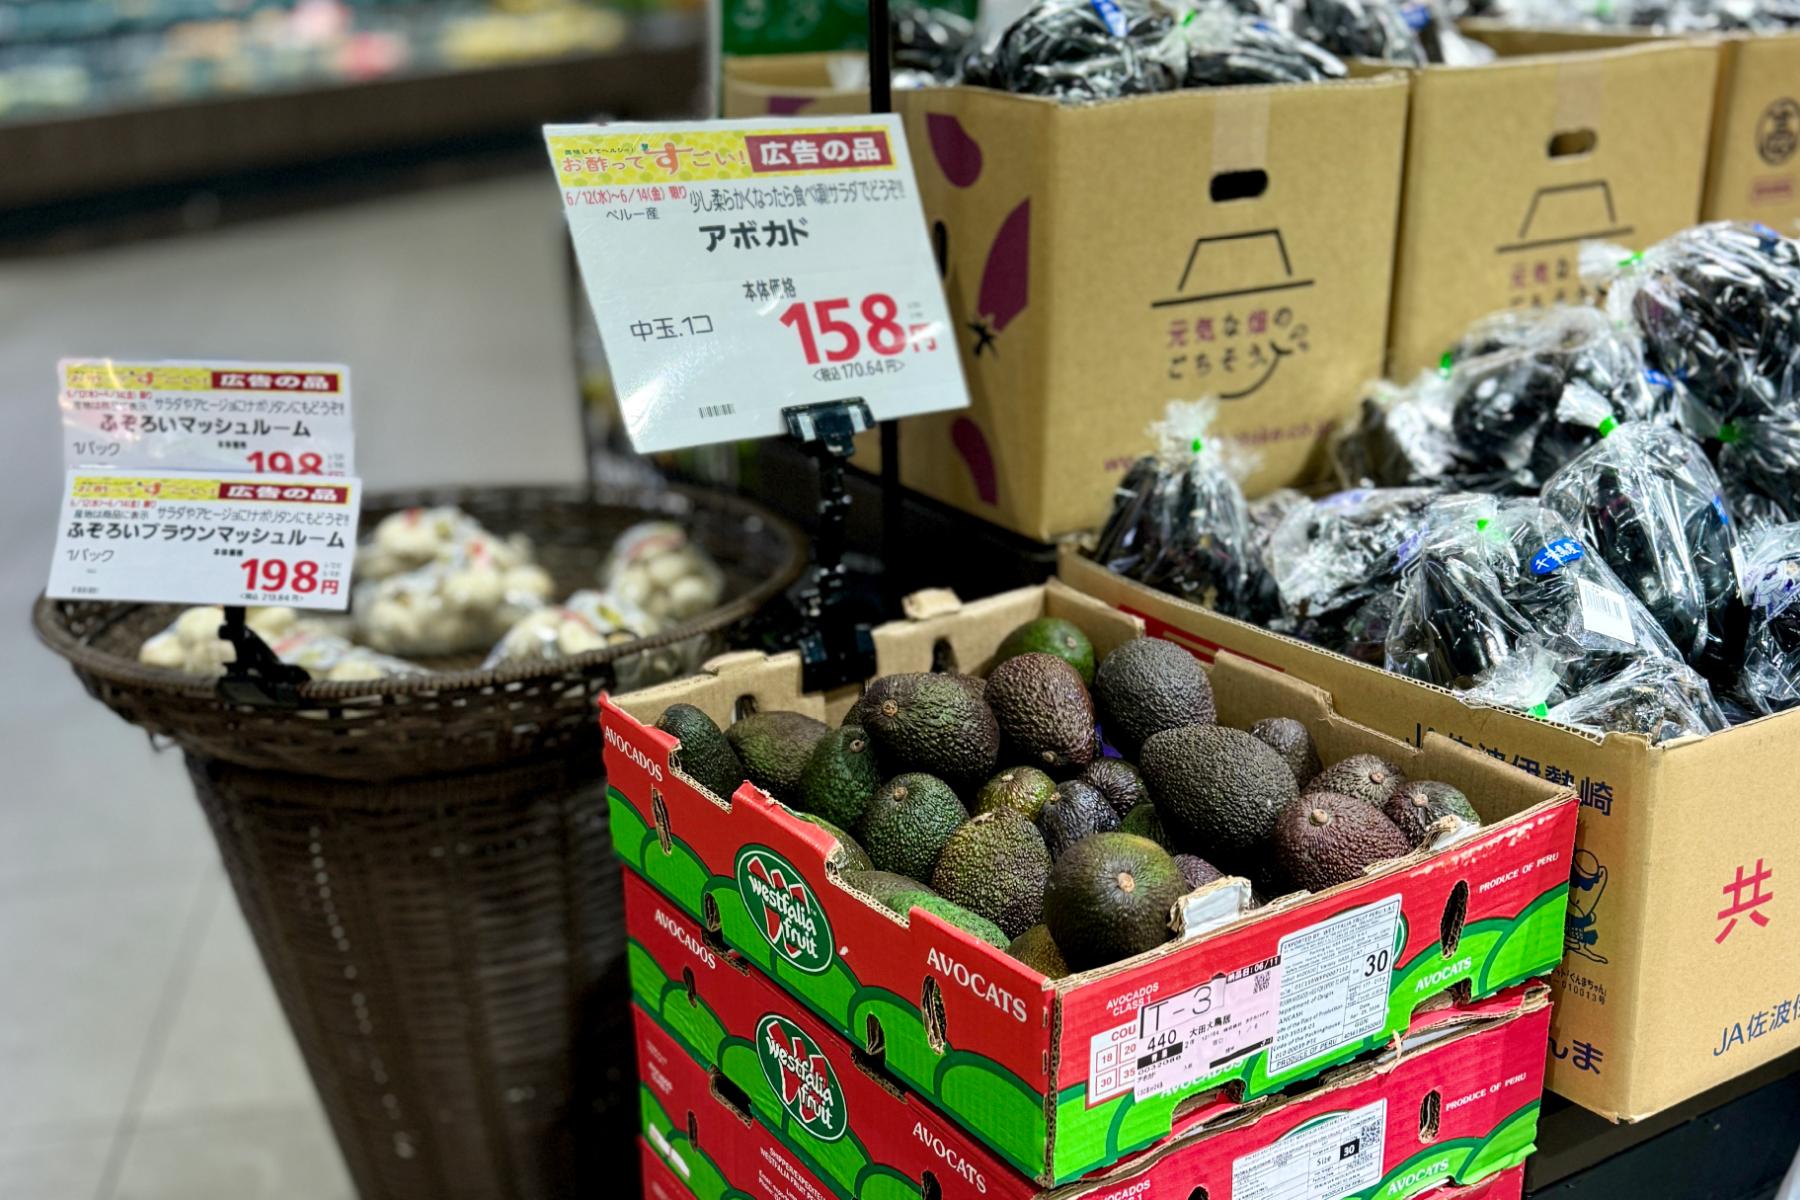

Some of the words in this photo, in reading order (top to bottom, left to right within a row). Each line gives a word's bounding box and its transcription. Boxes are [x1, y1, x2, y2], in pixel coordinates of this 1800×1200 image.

[760, 137, 880, 166] 広告の品
[606, 207, 660, 221] ペルー産
[699, 216, 809, 252] アボカド
[742, 277, 797, 302] 本体価格
[220, 374, 329, 390] 広告の品
[100, 413, 311, 438] ふぞろいマッシュルーム
[228, 485, 337, 501] 広告の品
[67, 521, 345, 549] ふぞろいブラウンマッシュルーム
[605, 725, 663, 782] AVOCADOS
[1478, 869, 1519, 893] PRODUCE
[1522, 862, 1533, 874] OF
[1536, 852, 1559, 867] PERU
[748, 875, 817, 936] westfalia
[1714, 857, 1774, 945] 共
[655, 908, 716, 970] AVOCADOS
[783, 917, 818, 959] fruit
[1364, 950, 1388, 977] 30
[1414, 956, 1472, 993] AVOCATS
[926, 946, 1028, 1023] AVOCATS
[1106, 983, 1159, 1011] AVOCADOS
[1113, 998, 1144, 1017] CLASS
[1111, 1024, 1137, 1042] COU
[1147, 1029, 1177, 1051] 440
[1102, 1053, 1113, 1064] 18
[1125, 1044, 1136, 1055] 20
[765, 1037, 834, 1107] westfalia
[1101, 1076, 1112, 1087] 30
[1123, 1068, 1135, 1079] 35
[801, 1083, 833, 1129] fruit
[1445, 1088, 1486, 1112] PRODUCE
[1490, 1081, 1502, 1093] OF
[1504, 1072, 1527, 1087] PERU
[911, 1121, 988, 1194] AVOCATS
[1343, 1144, 1355, 1156] 30
[1387, 1158, 1449, 1196] AVOCATS
